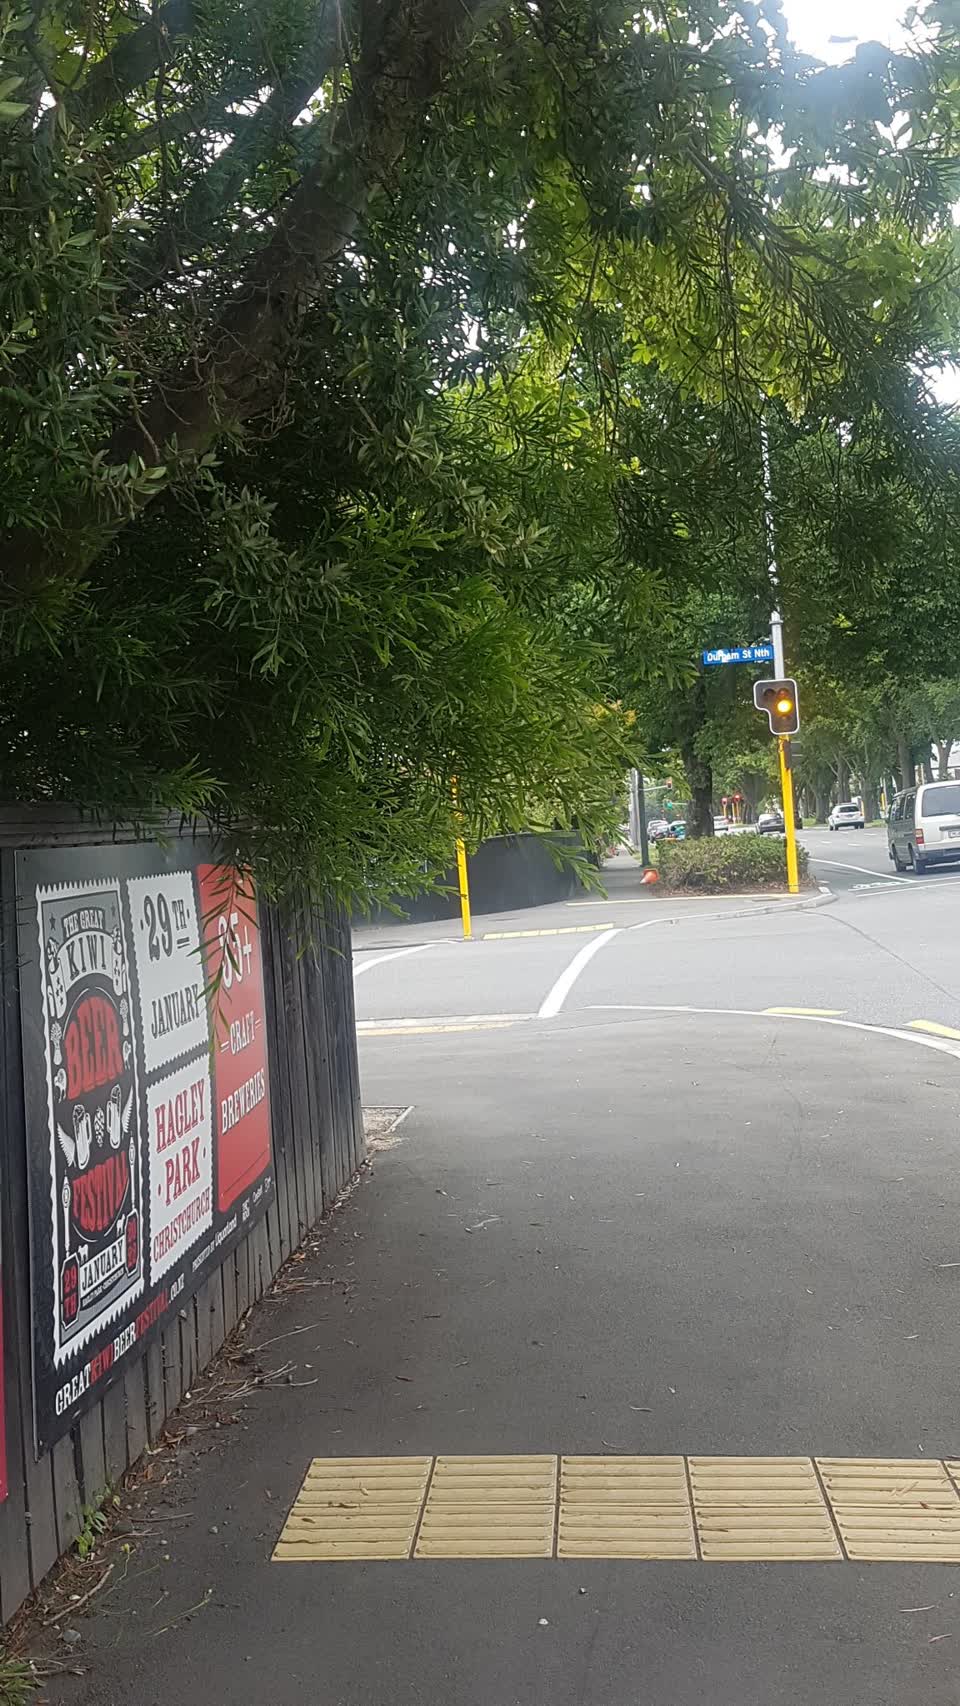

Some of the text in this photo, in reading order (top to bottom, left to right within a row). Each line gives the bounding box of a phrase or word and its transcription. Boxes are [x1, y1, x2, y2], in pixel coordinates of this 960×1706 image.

[707, 648, 769, 662] Durham St Nth
[63, 909, 103, 938] THE GREAT
[66, 934, 106, 980] KIWI
[151, 983, 200, 1039] JANUARY
[230, 1010, 255, 1055] CRAFT
[65, 998, 123, 1099] BEER
[155, 1078, 205, 1153] HAGLEY
[221, 1068, 265, 1136] BREWERIES
[72, 1151, 128, 1232] FESTIVAL
[165, 1136, 200, 1206] PARK
[153, 1186, 210, 1263] CHRISTCHURCH
[64, 1265, 77, 1293] 29
[81, 1240, 124, 1291] JANUARY
